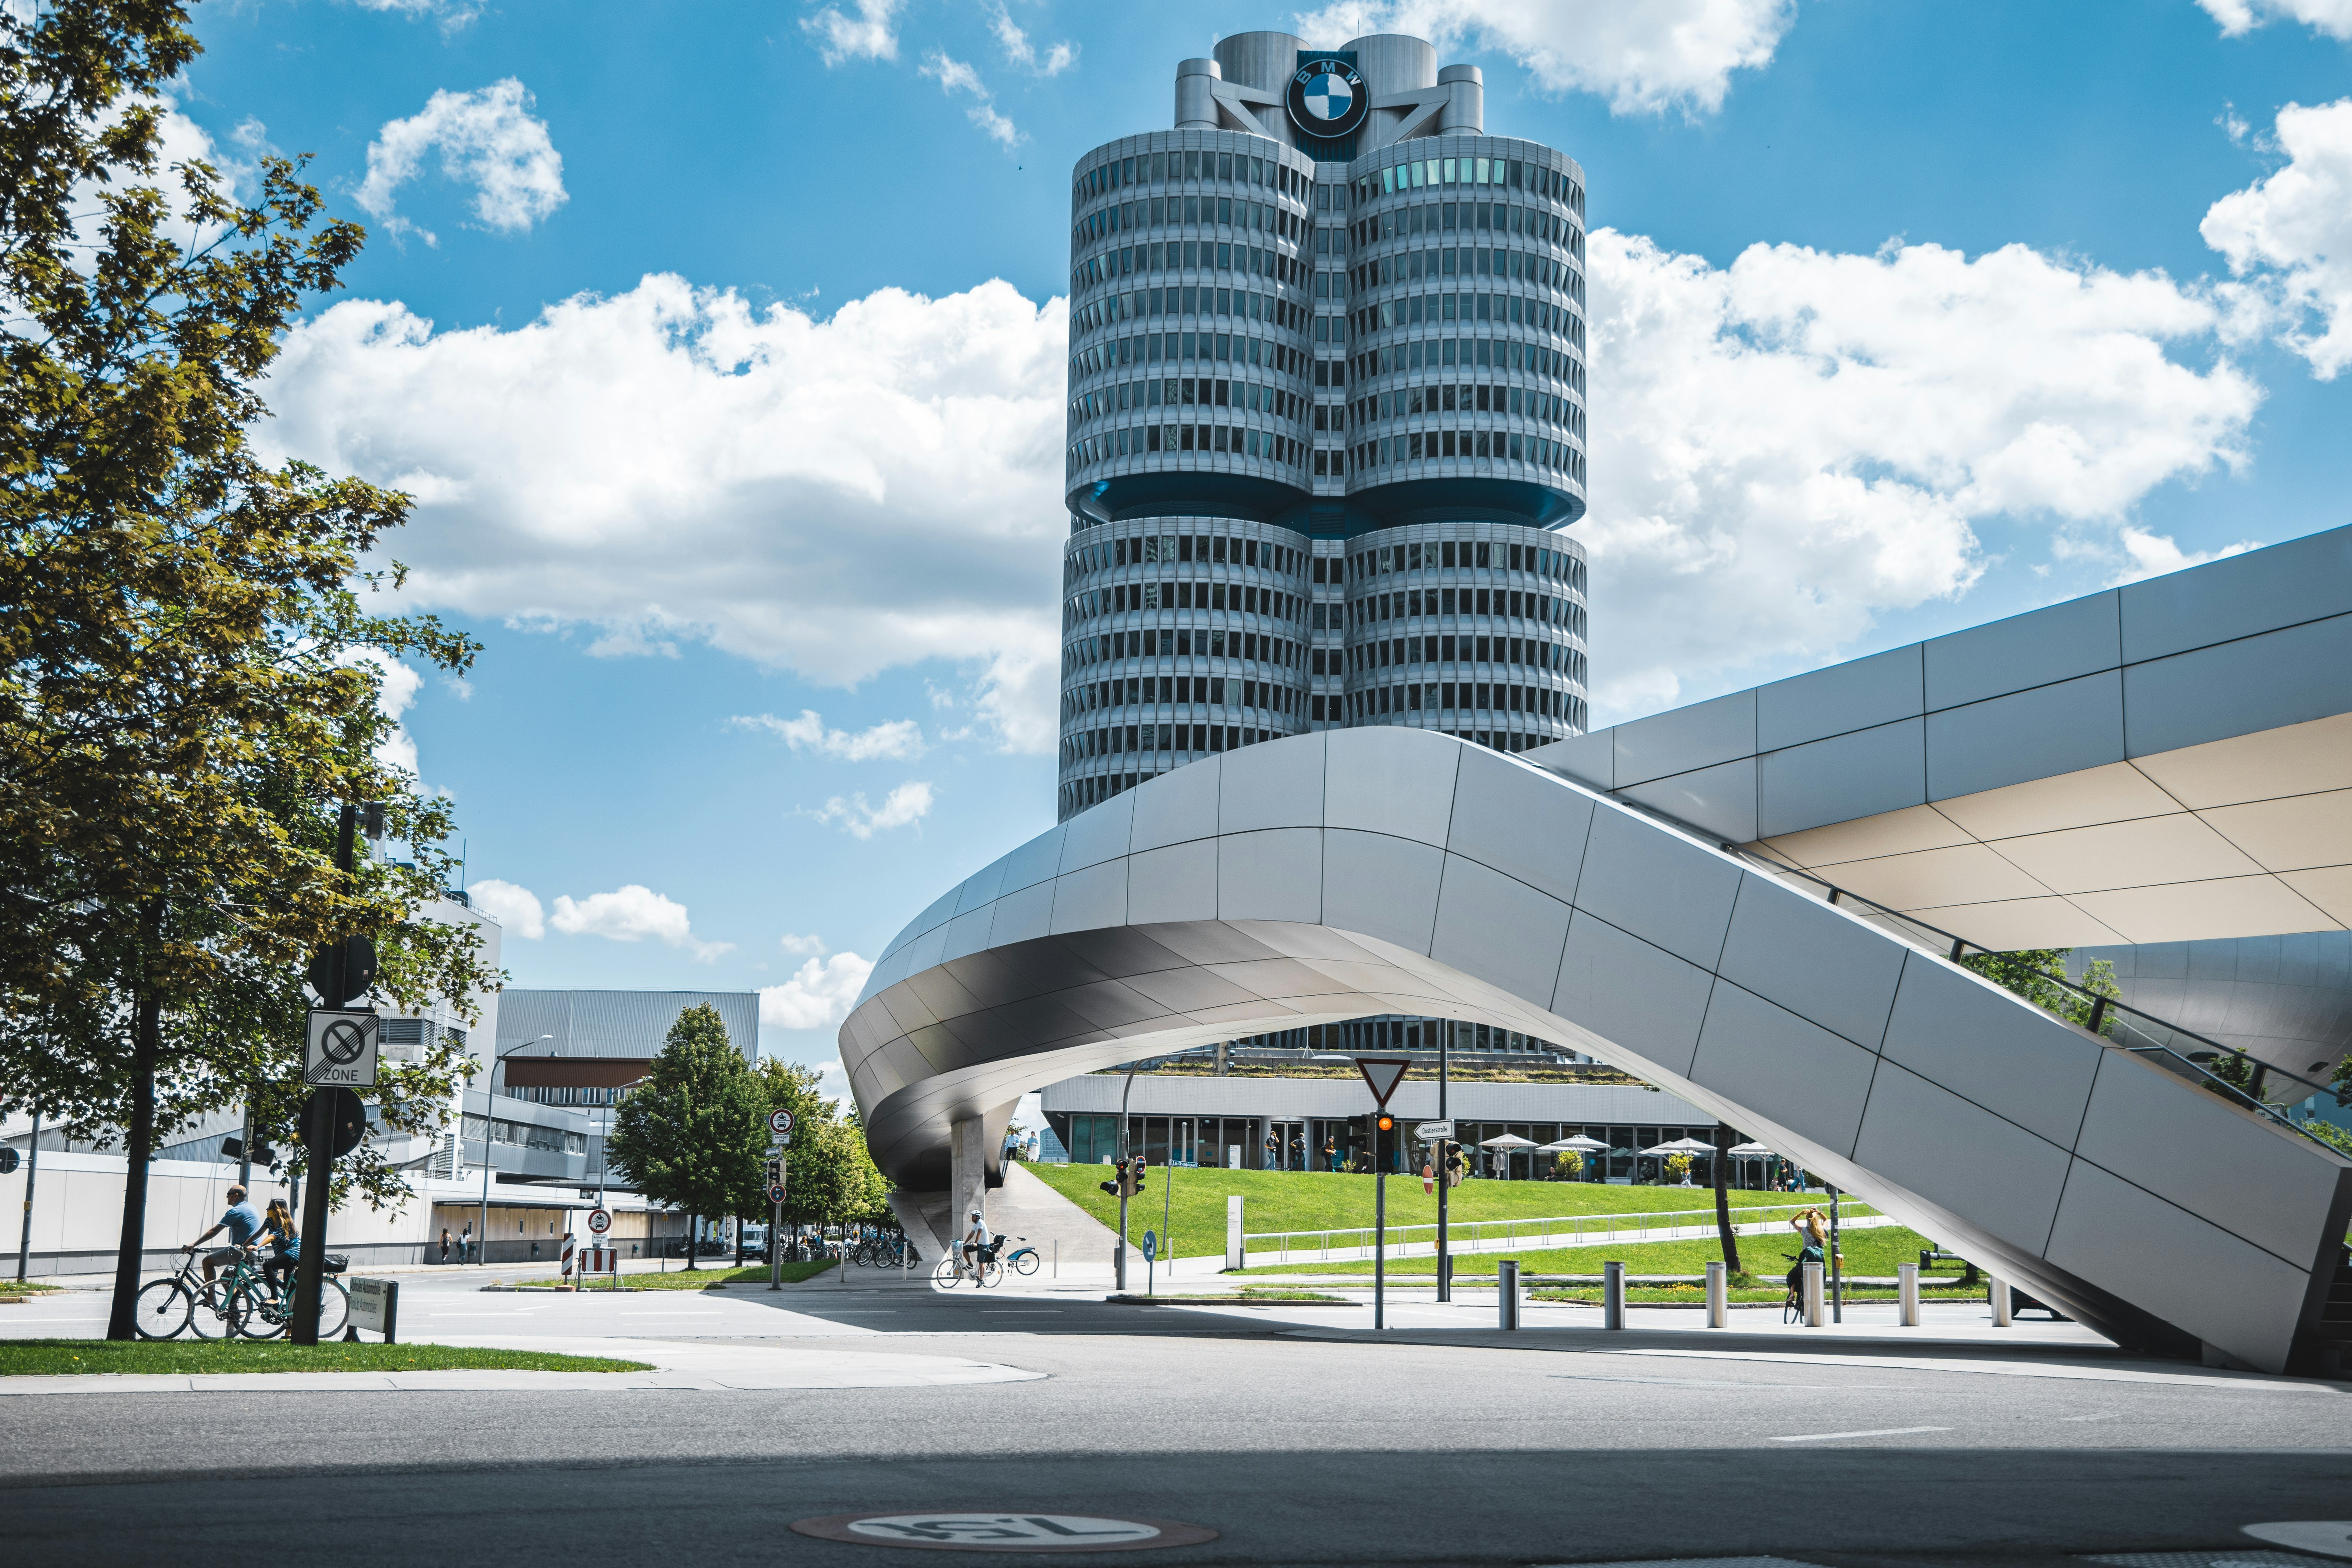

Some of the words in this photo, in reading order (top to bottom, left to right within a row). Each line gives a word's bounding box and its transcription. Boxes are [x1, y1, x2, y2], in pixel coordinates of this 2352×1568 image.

[1296, 62, 1361, 85] BMW
[323, 1069, 359, 1081] ZONE
[350, 1278, 363, 1293] Abholer
[362, 1280, 381, 1296] Automobile
[359, 1298, 377, 1314] Automobiles
